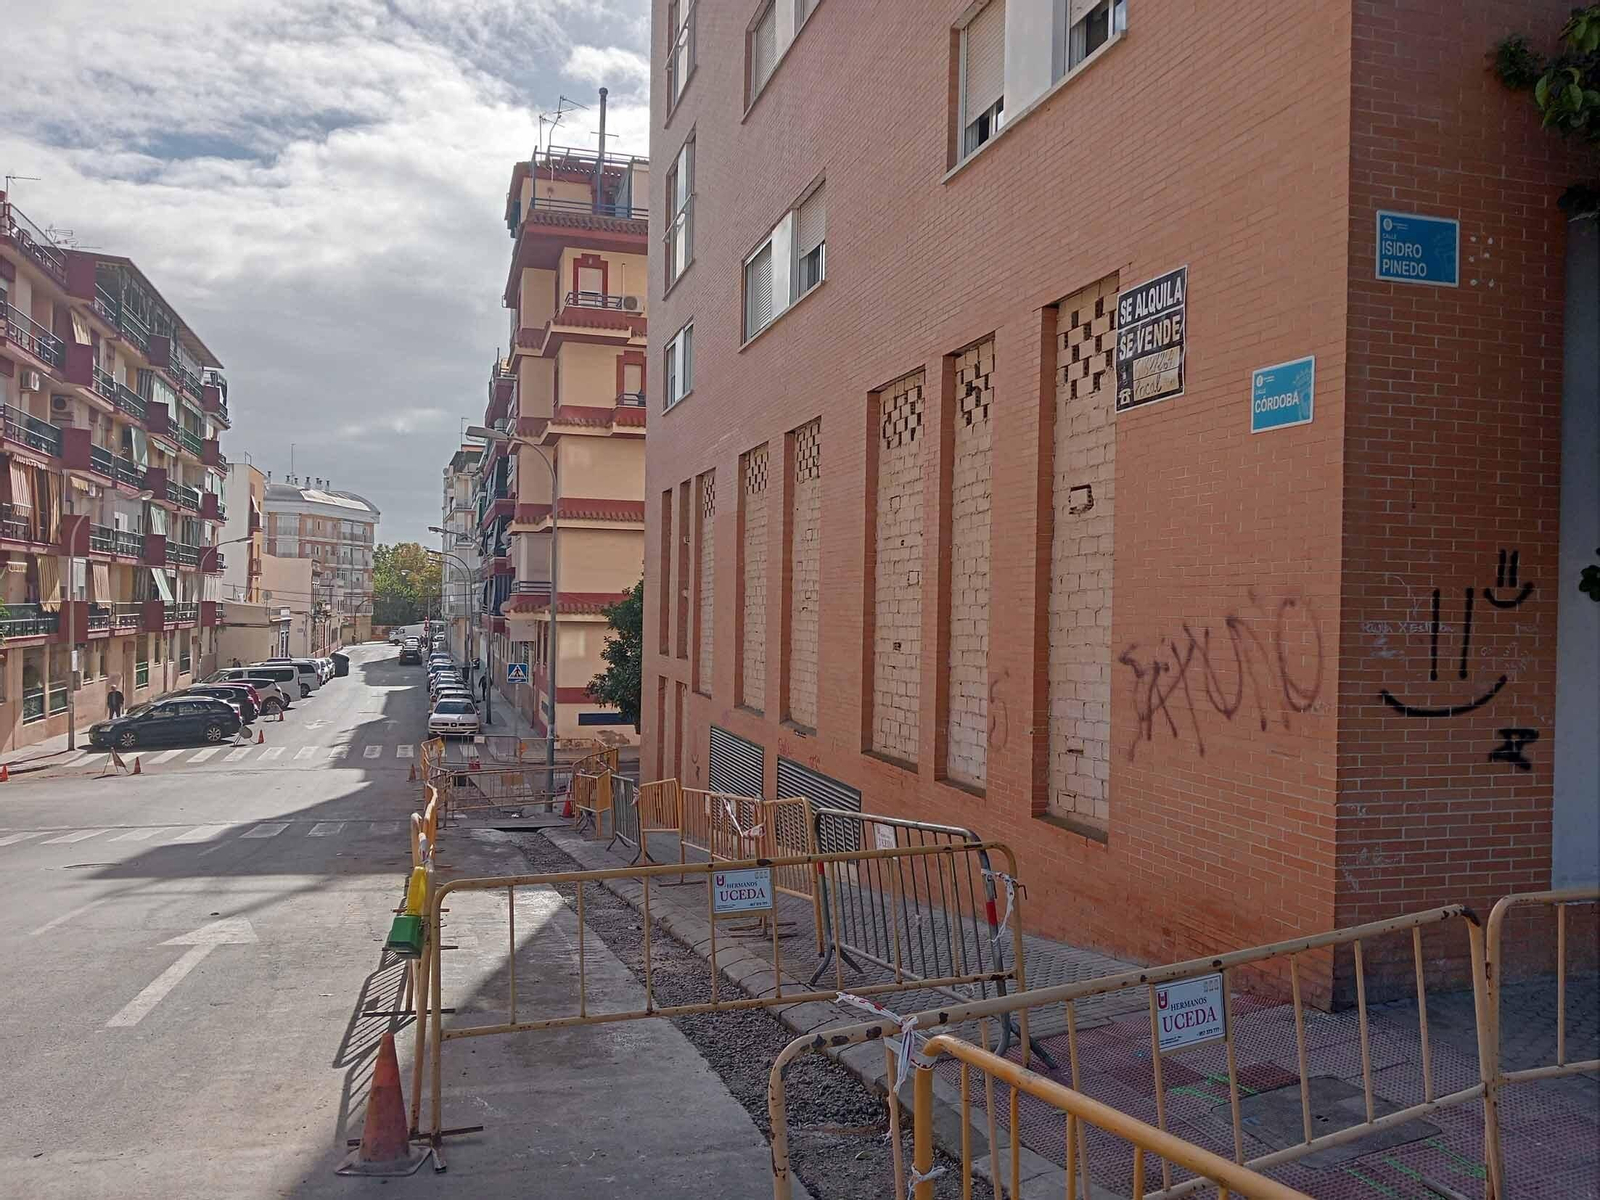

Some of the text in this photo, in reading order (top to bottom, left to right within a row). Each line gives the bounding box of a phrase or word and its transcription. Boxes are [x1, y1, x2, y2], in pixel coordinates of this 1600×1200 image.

[1382, 241, 1422, 258] ISIDRO
[1382, 259, 1427, 277] PINEDO
[1120, 276, 1182, 325] SE ALQUILA
[1119, 314, 1181, 361] SE VENDE
[1254, 390, 1300, 413] CÓRDOBA
[726, 881, 758, 889] HERMANOS
[720, 887, 766, 902] UCEDA
[1170, 997, 1207, 1011] HERMANOS
[1162, 1006, 1218, 1033] UCEDA
